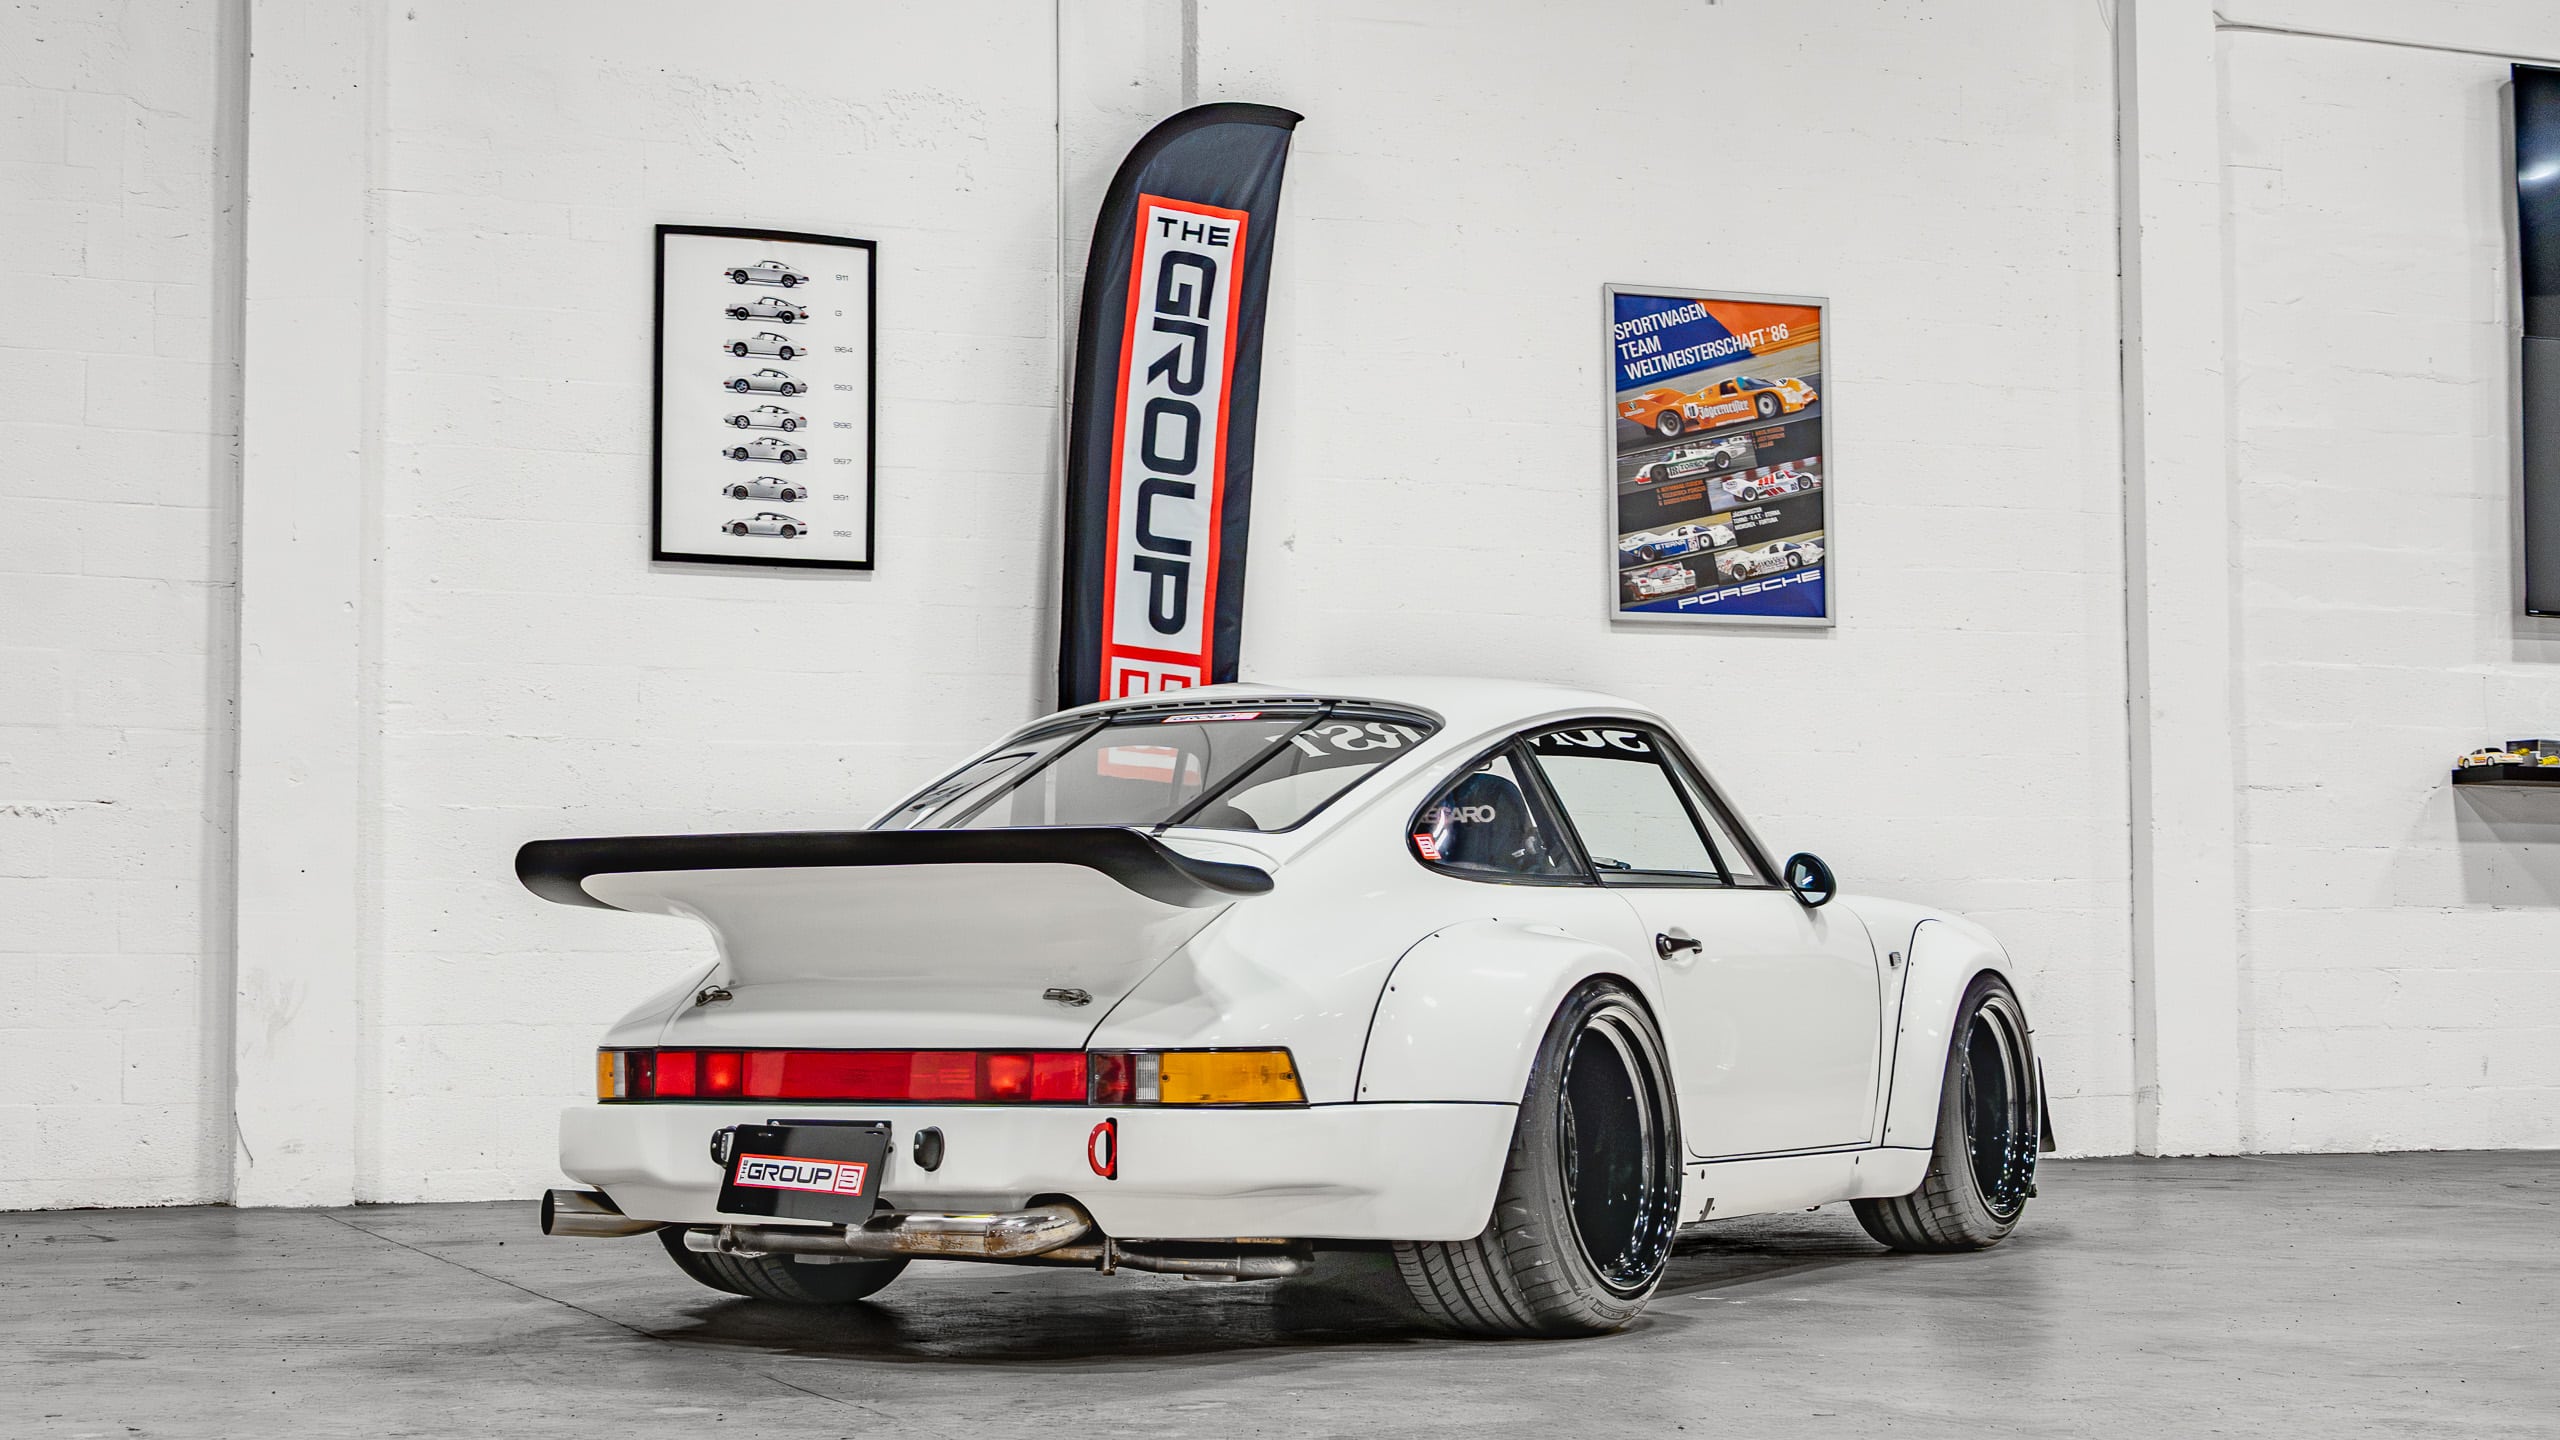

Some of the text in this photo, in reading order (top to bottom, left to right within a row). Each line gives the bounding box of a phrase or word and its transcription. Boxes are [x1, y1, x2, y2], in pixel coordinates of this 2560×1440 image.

[1157, 216, 1231, 247] THE
[1614, 303, 1709, 341] SPORTWAGEN
[1618, 335, 1662, 360] TEAM
[1624, 328, 1766, 380] WELTMEISTERSCHAFT
[1133, 250, 1217, 635] GROUP
[833, 457, 853, 465] 997
[833, 530, 853, 538] 992
[1678, 569, 1822, 609] PORSCHE
[739, 1159, 749, 1181] THE
[747, 1163, 832, 1185] GROUP
